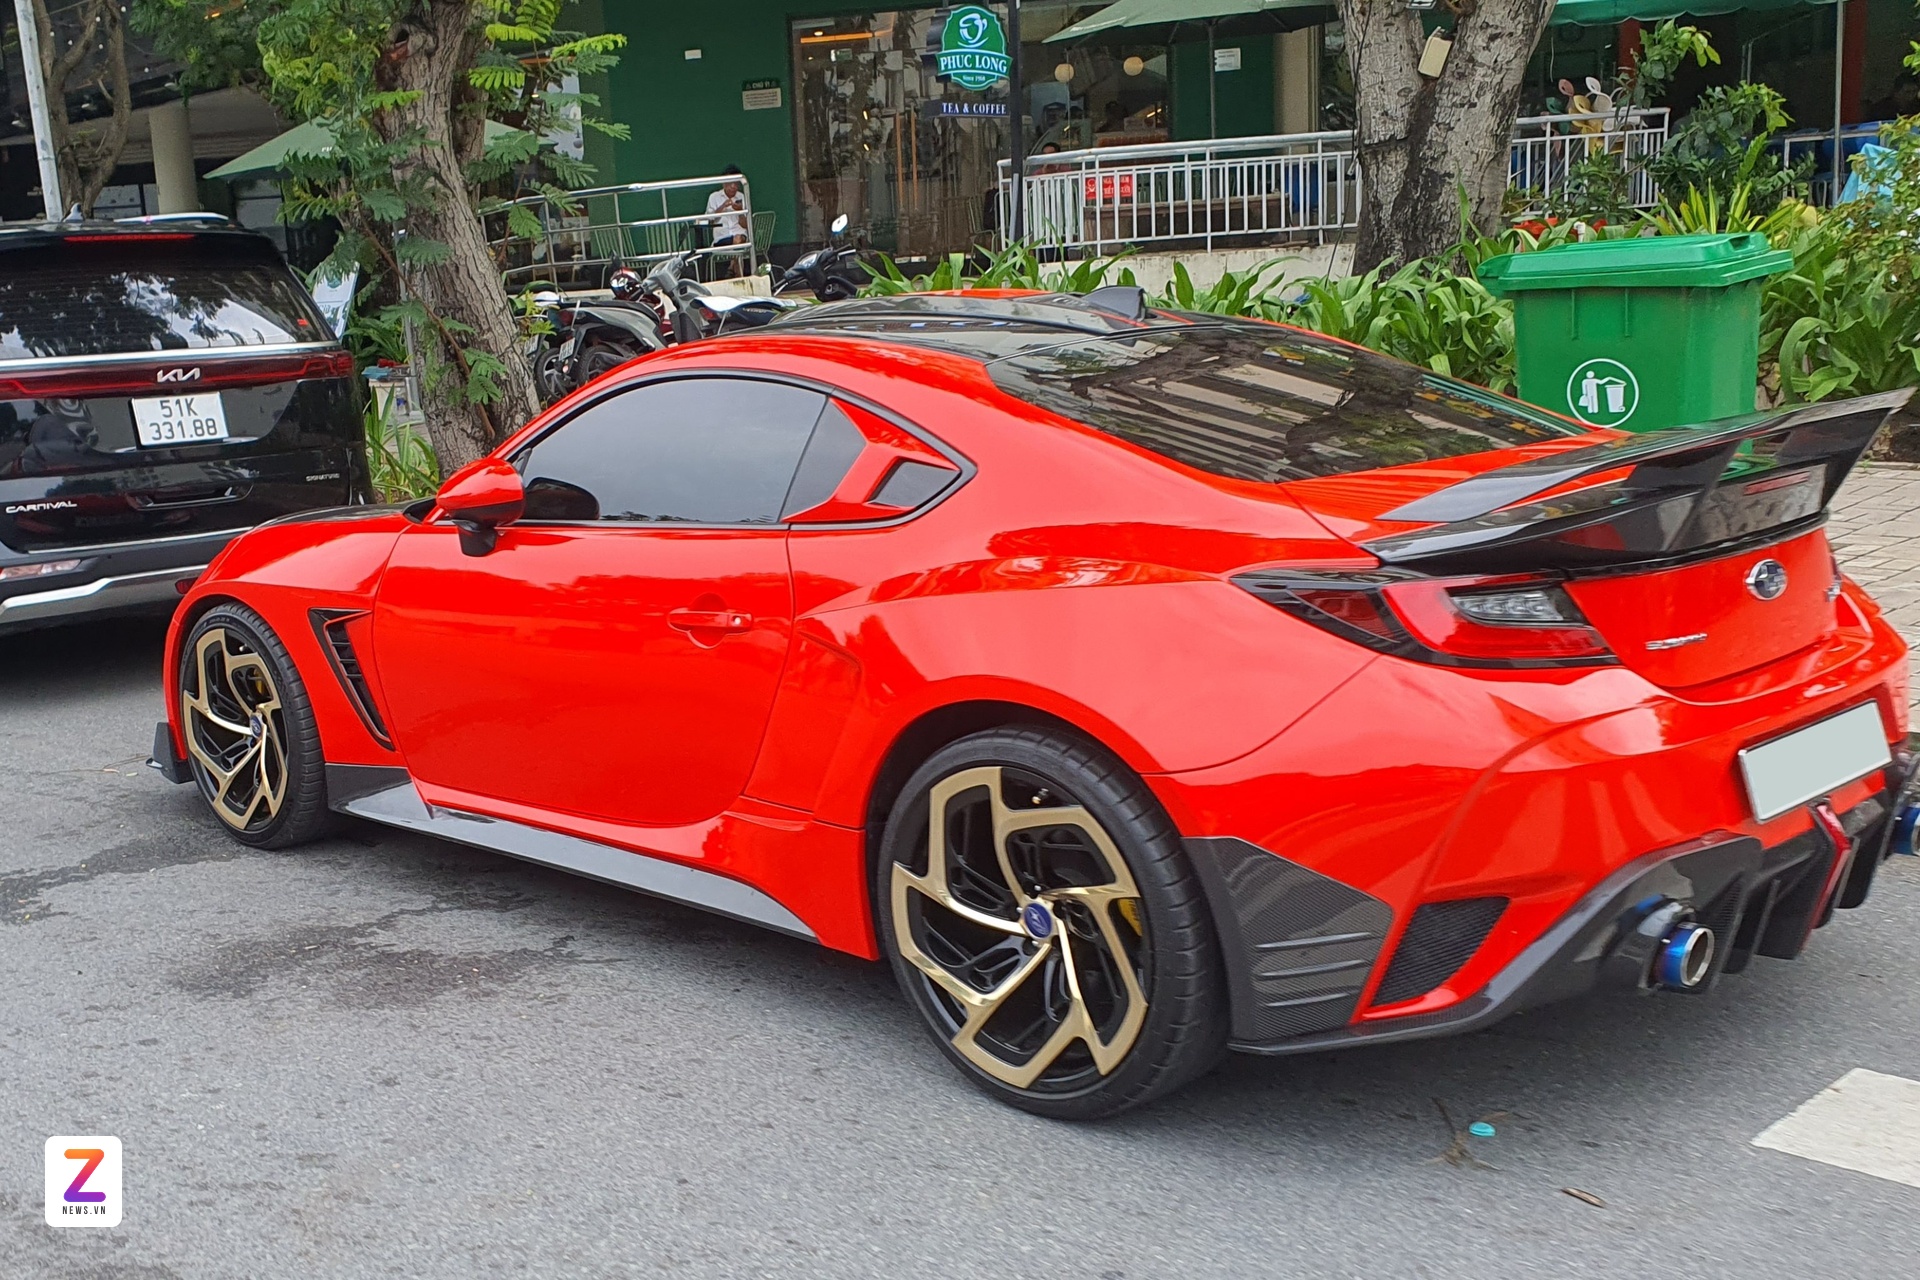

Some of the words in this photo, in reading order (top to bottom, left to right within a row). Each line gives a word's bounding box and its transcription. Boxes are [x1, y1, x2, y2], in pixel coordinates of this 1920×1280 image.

[940, 55, 972, 71] PHUC
[975, 56, 1007, 73] LONG
[942, 102, 959, 114] TEA
[962, 102, 969, 114] &
[973, 103, 1006, 114] COFFEE
[157, 367, 200, 383] KIA
[160, 398, 198, 418] 51K
[149, 418, 217, 440] 331.88
[5, 501, 77, 513] CARNIVAL
